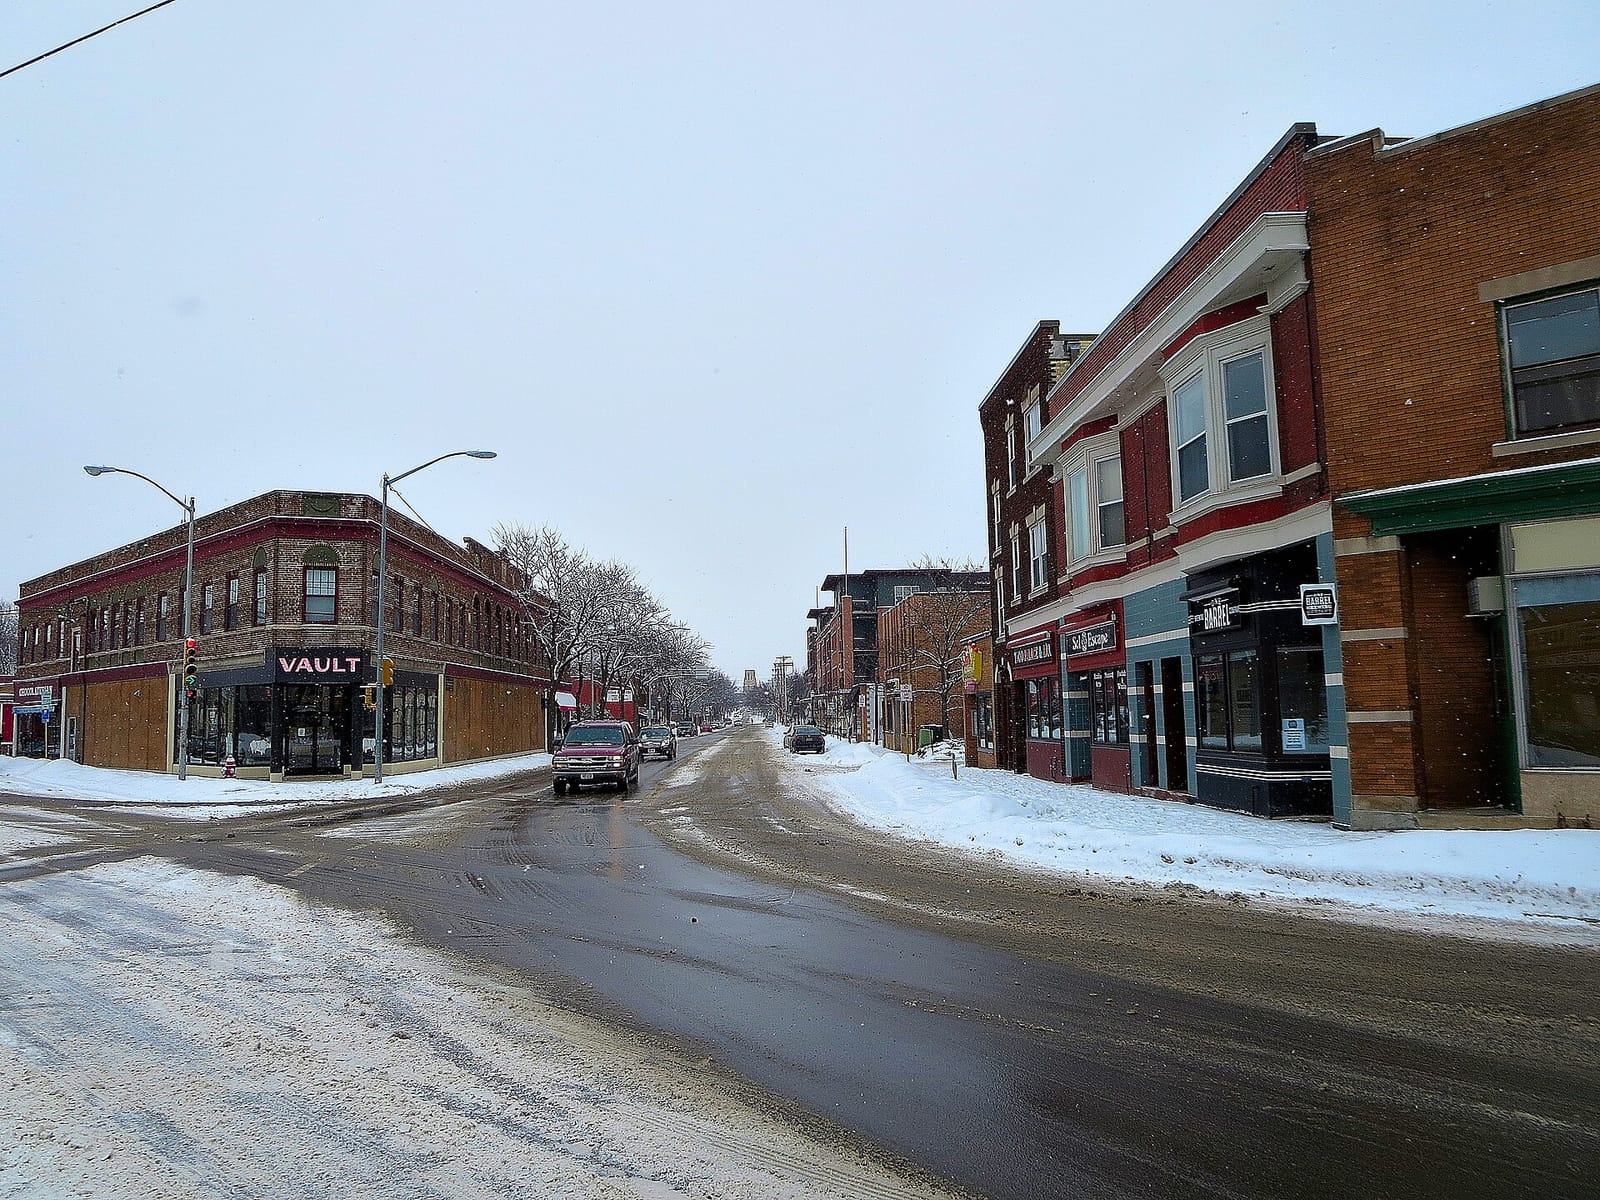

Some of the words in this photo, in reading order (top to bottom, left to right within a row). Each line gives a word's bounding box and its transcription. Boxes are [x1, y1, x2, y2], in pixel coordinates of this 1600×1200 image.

[1305, 596, 1332, 606] BARREL
[1203, 603, 1231, 630] BARREL
[278, 657, 361, 673] VAULT
